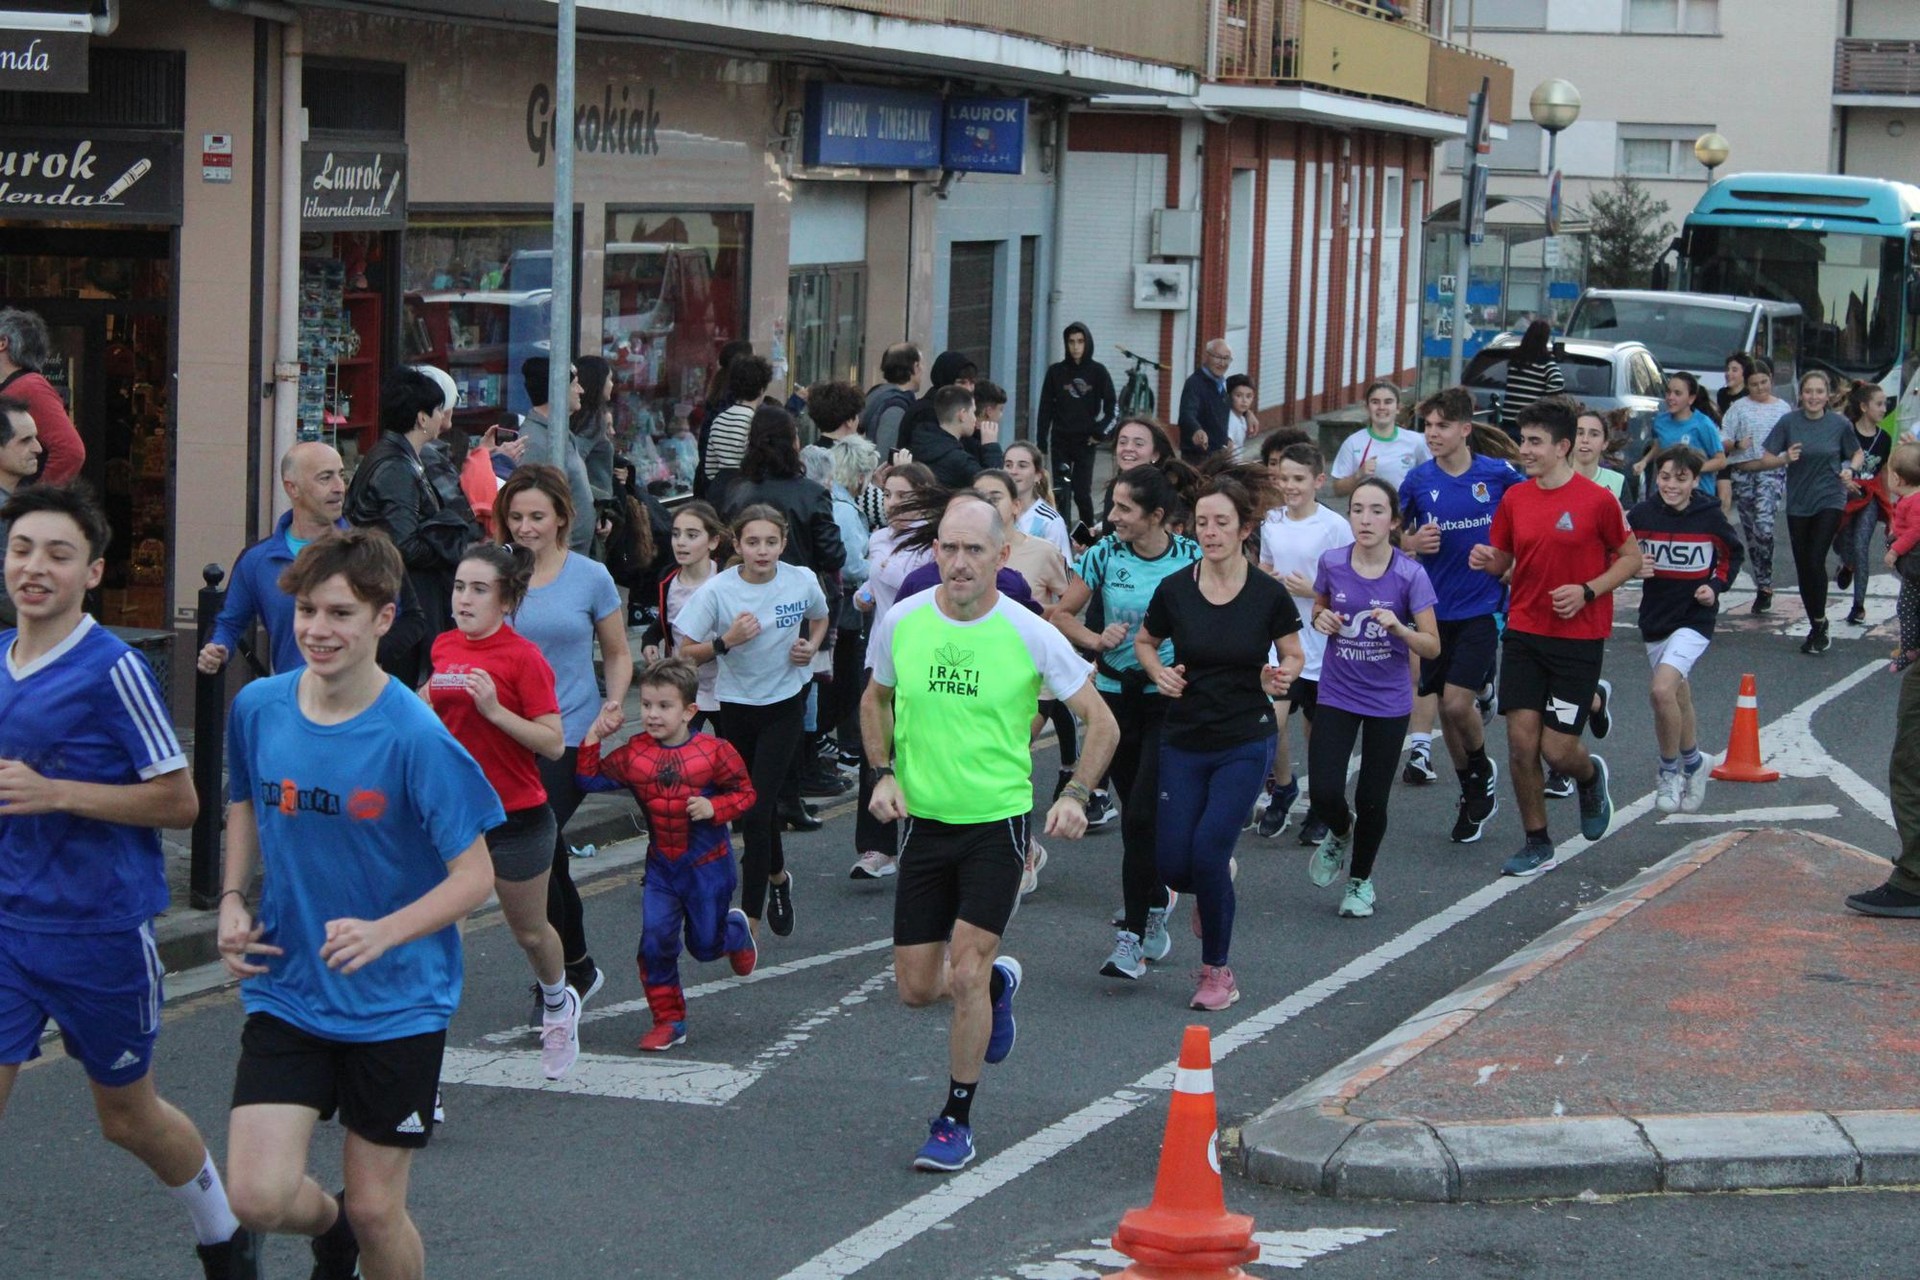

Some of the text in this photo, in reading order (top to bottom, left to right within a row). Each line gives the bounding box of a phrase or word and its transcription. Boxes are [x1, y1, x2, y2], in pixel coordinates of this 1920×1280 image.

[827, 101, 933, 142] LAUROK ZINEBANK
[949, 104, 1018, 122] LAUROK
[313, 152, 382, 191] Laurok
[302, 197, 383, 217] liburudenda
[1438, 320, 1453, 335] AS
[929, 665, 979, 683] IRATI
[928, 680, 978, 697] XTREM
